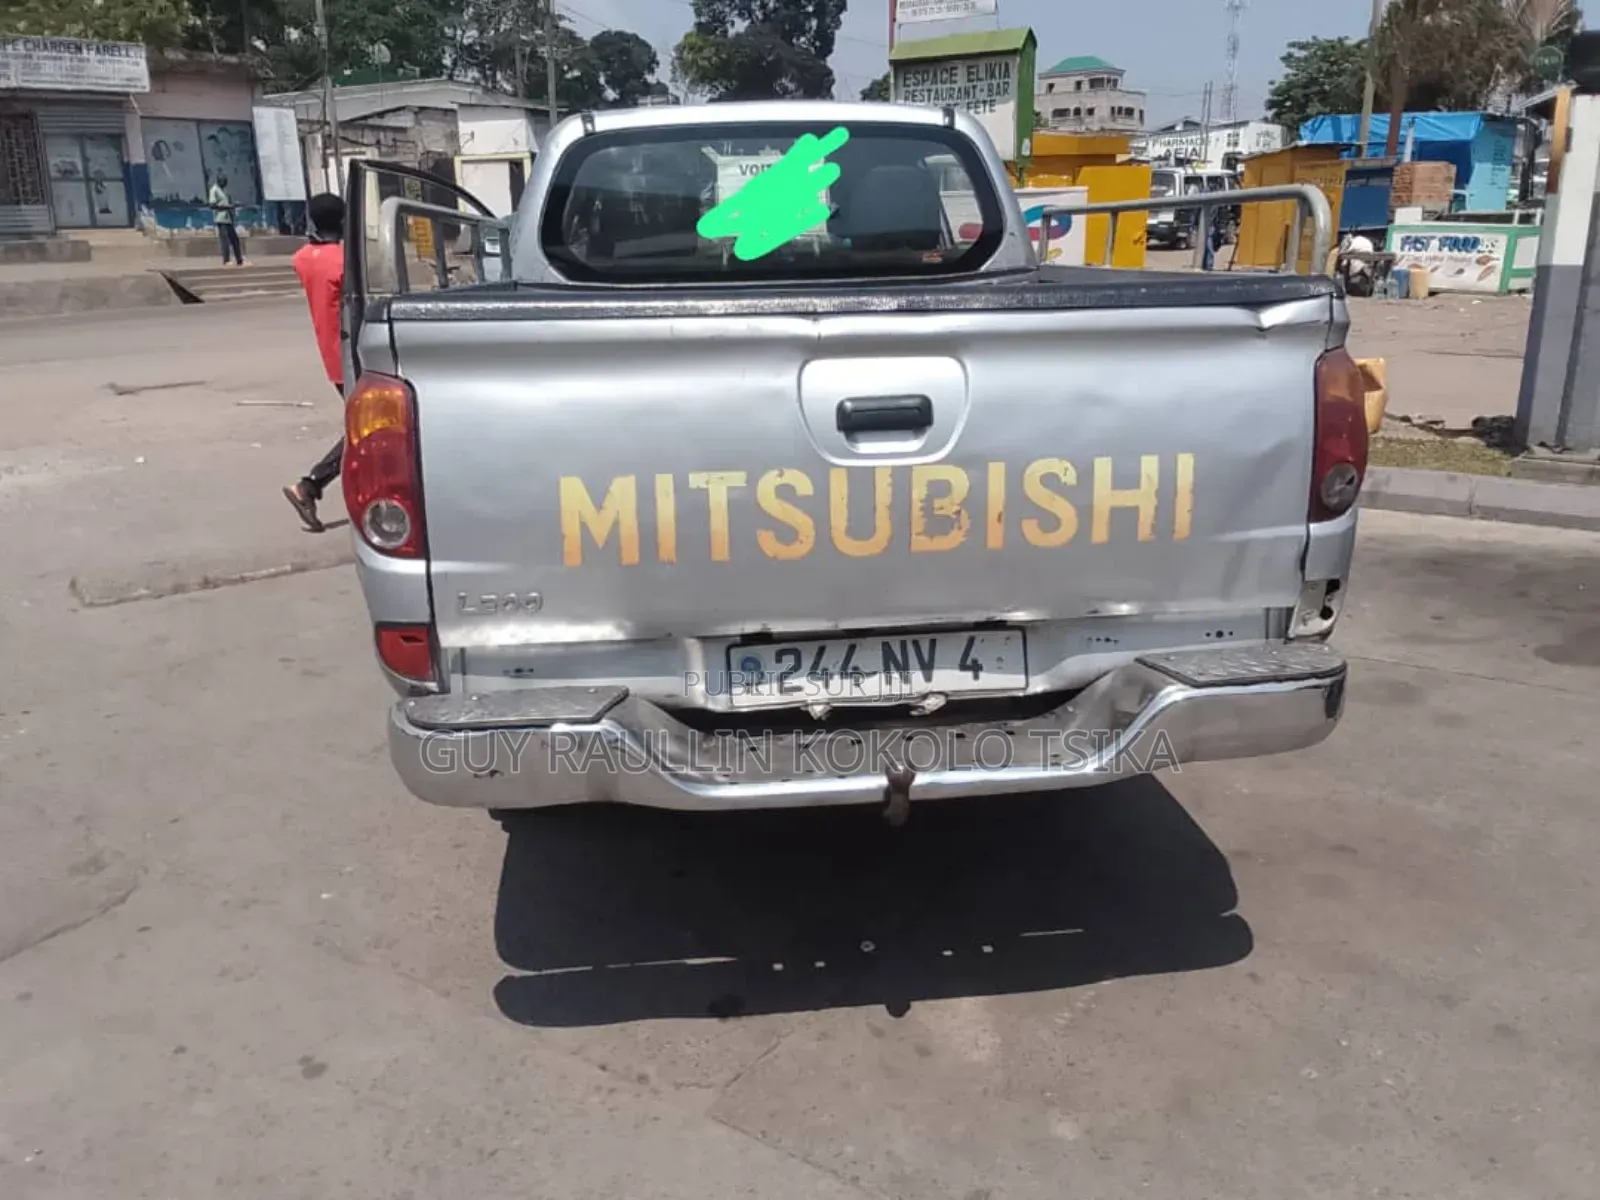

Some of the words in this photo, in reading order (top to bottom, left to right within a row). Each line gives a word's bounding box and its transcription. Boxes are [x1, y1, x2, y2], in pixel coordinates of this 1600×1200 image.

[903, 66, 958, 88] ESPACE
[966, 61, 1010, 83] ELIKIA
[559, 452, 1196, 568] MITSUBISHI
[775, 642, 866, 694] 244
[880, 638, 937, 686] NV
[957, 634, 984, 681] 4
